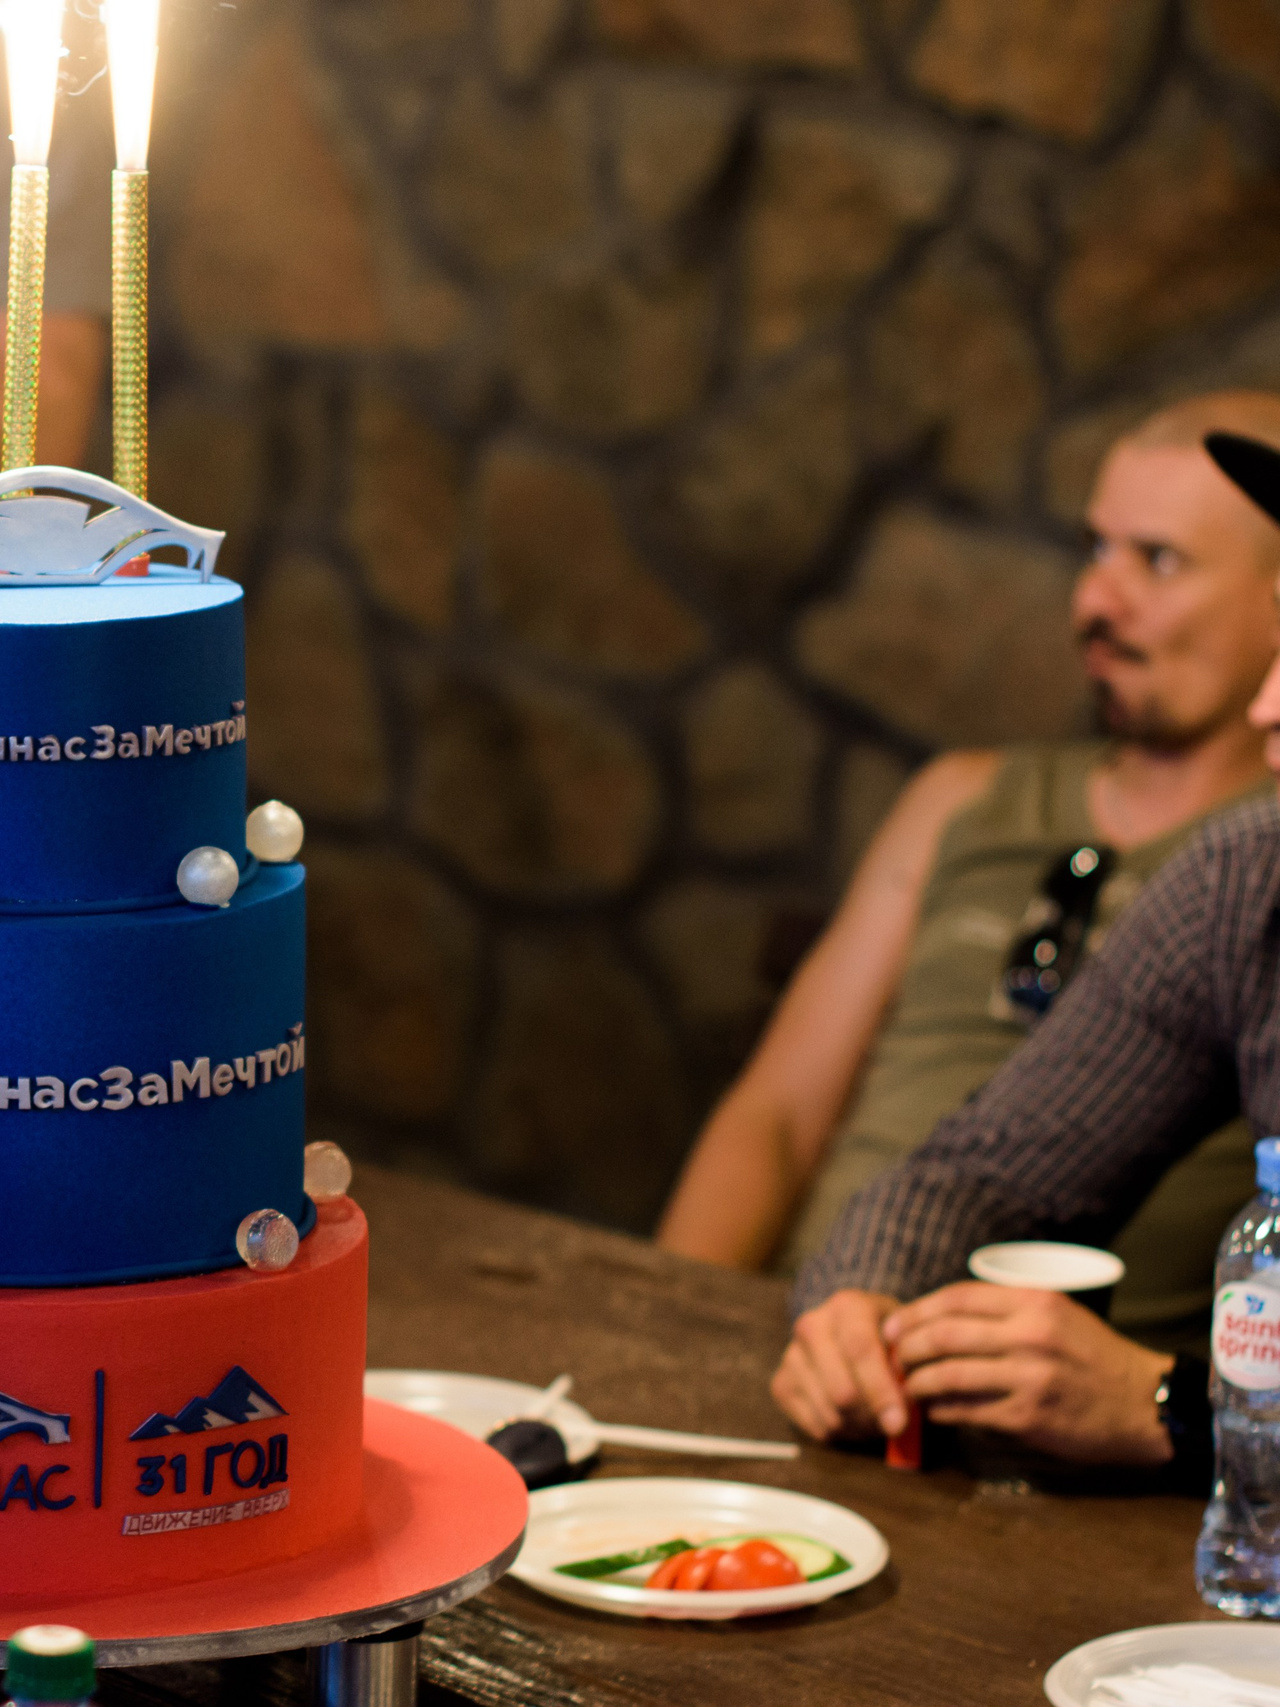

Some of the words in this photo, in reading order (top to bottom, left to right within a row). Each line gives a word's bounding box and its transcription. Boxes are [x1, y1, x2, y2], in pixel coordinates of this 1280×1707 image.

[136, 1454, 187, 1496] 31
[203, 1433, 289, 1496] ГОД
[127, 1504, 235, 1533] ДВИЖЕНИЕ
